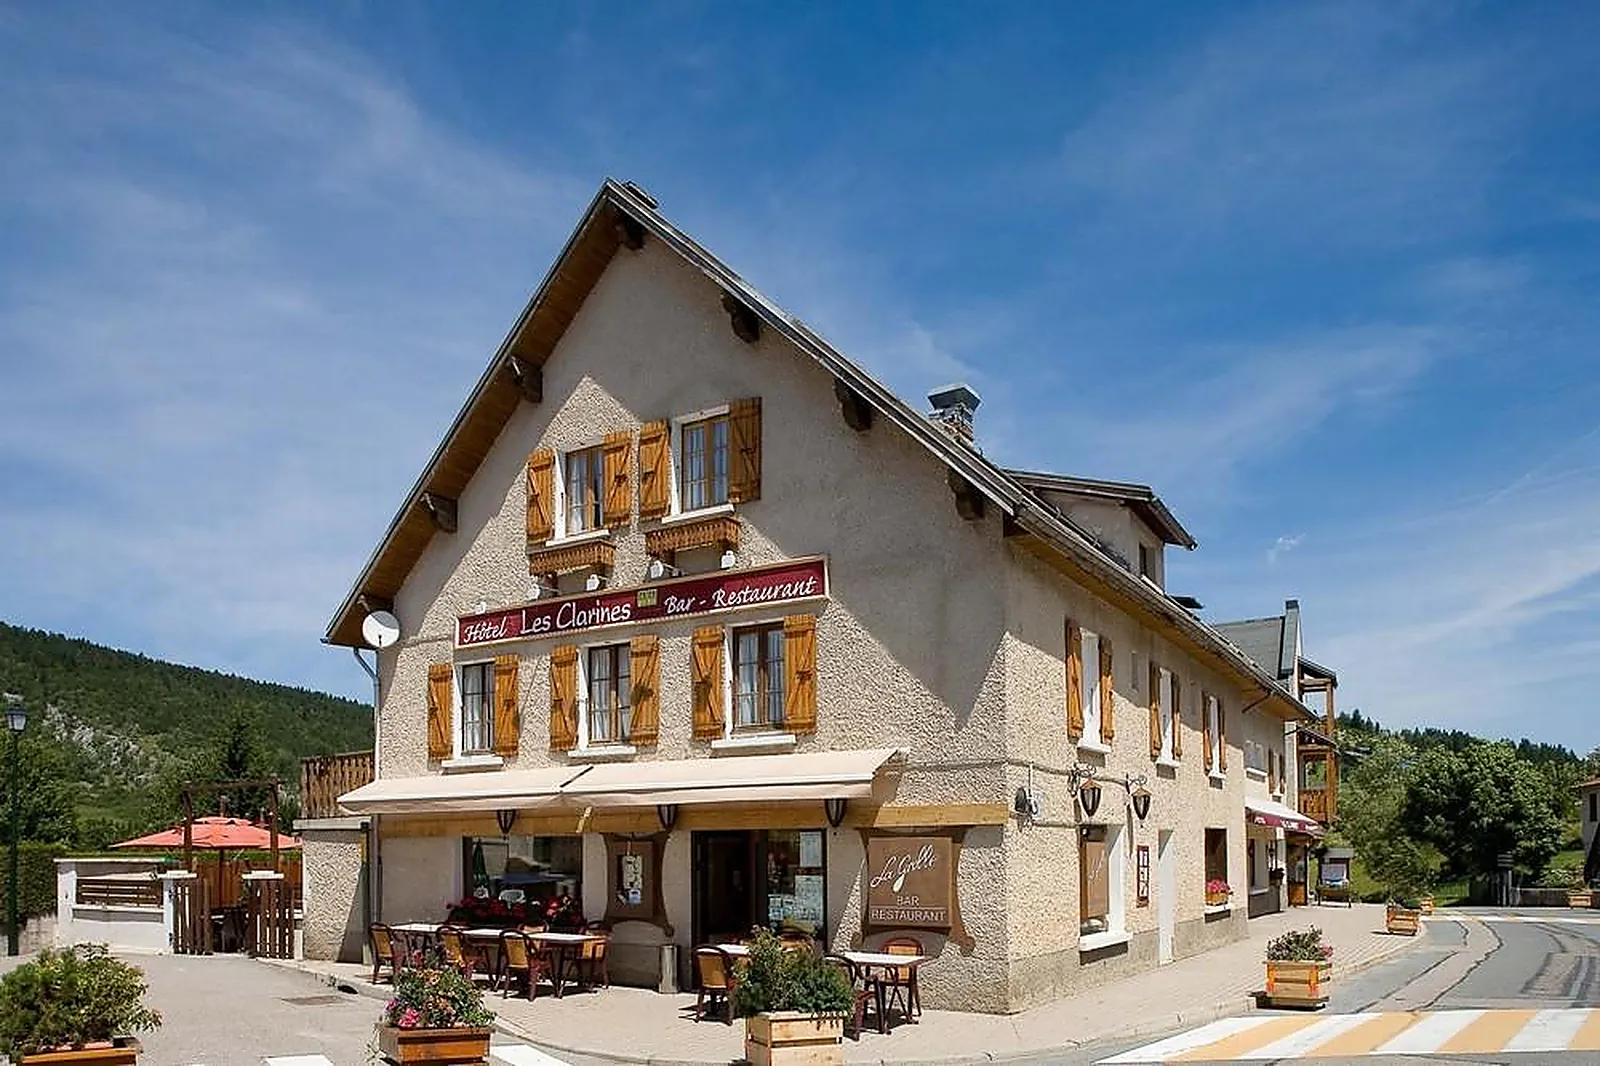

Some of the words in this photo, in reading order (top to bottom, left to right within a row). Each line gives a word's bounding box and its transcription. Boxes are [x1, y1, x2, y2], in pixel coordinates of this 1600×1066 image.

[664, 595, 696, 613] Bar
[712, 575, 817, 607] Restaurant
[463, 616, 507, 643] Hôtel
[520, 609, 551, 634] Les
[556, 600, 631, 629] Clarines
[897, 895, 920, 906] BAR
[871, 909, 945, 921] RESTAURANT
